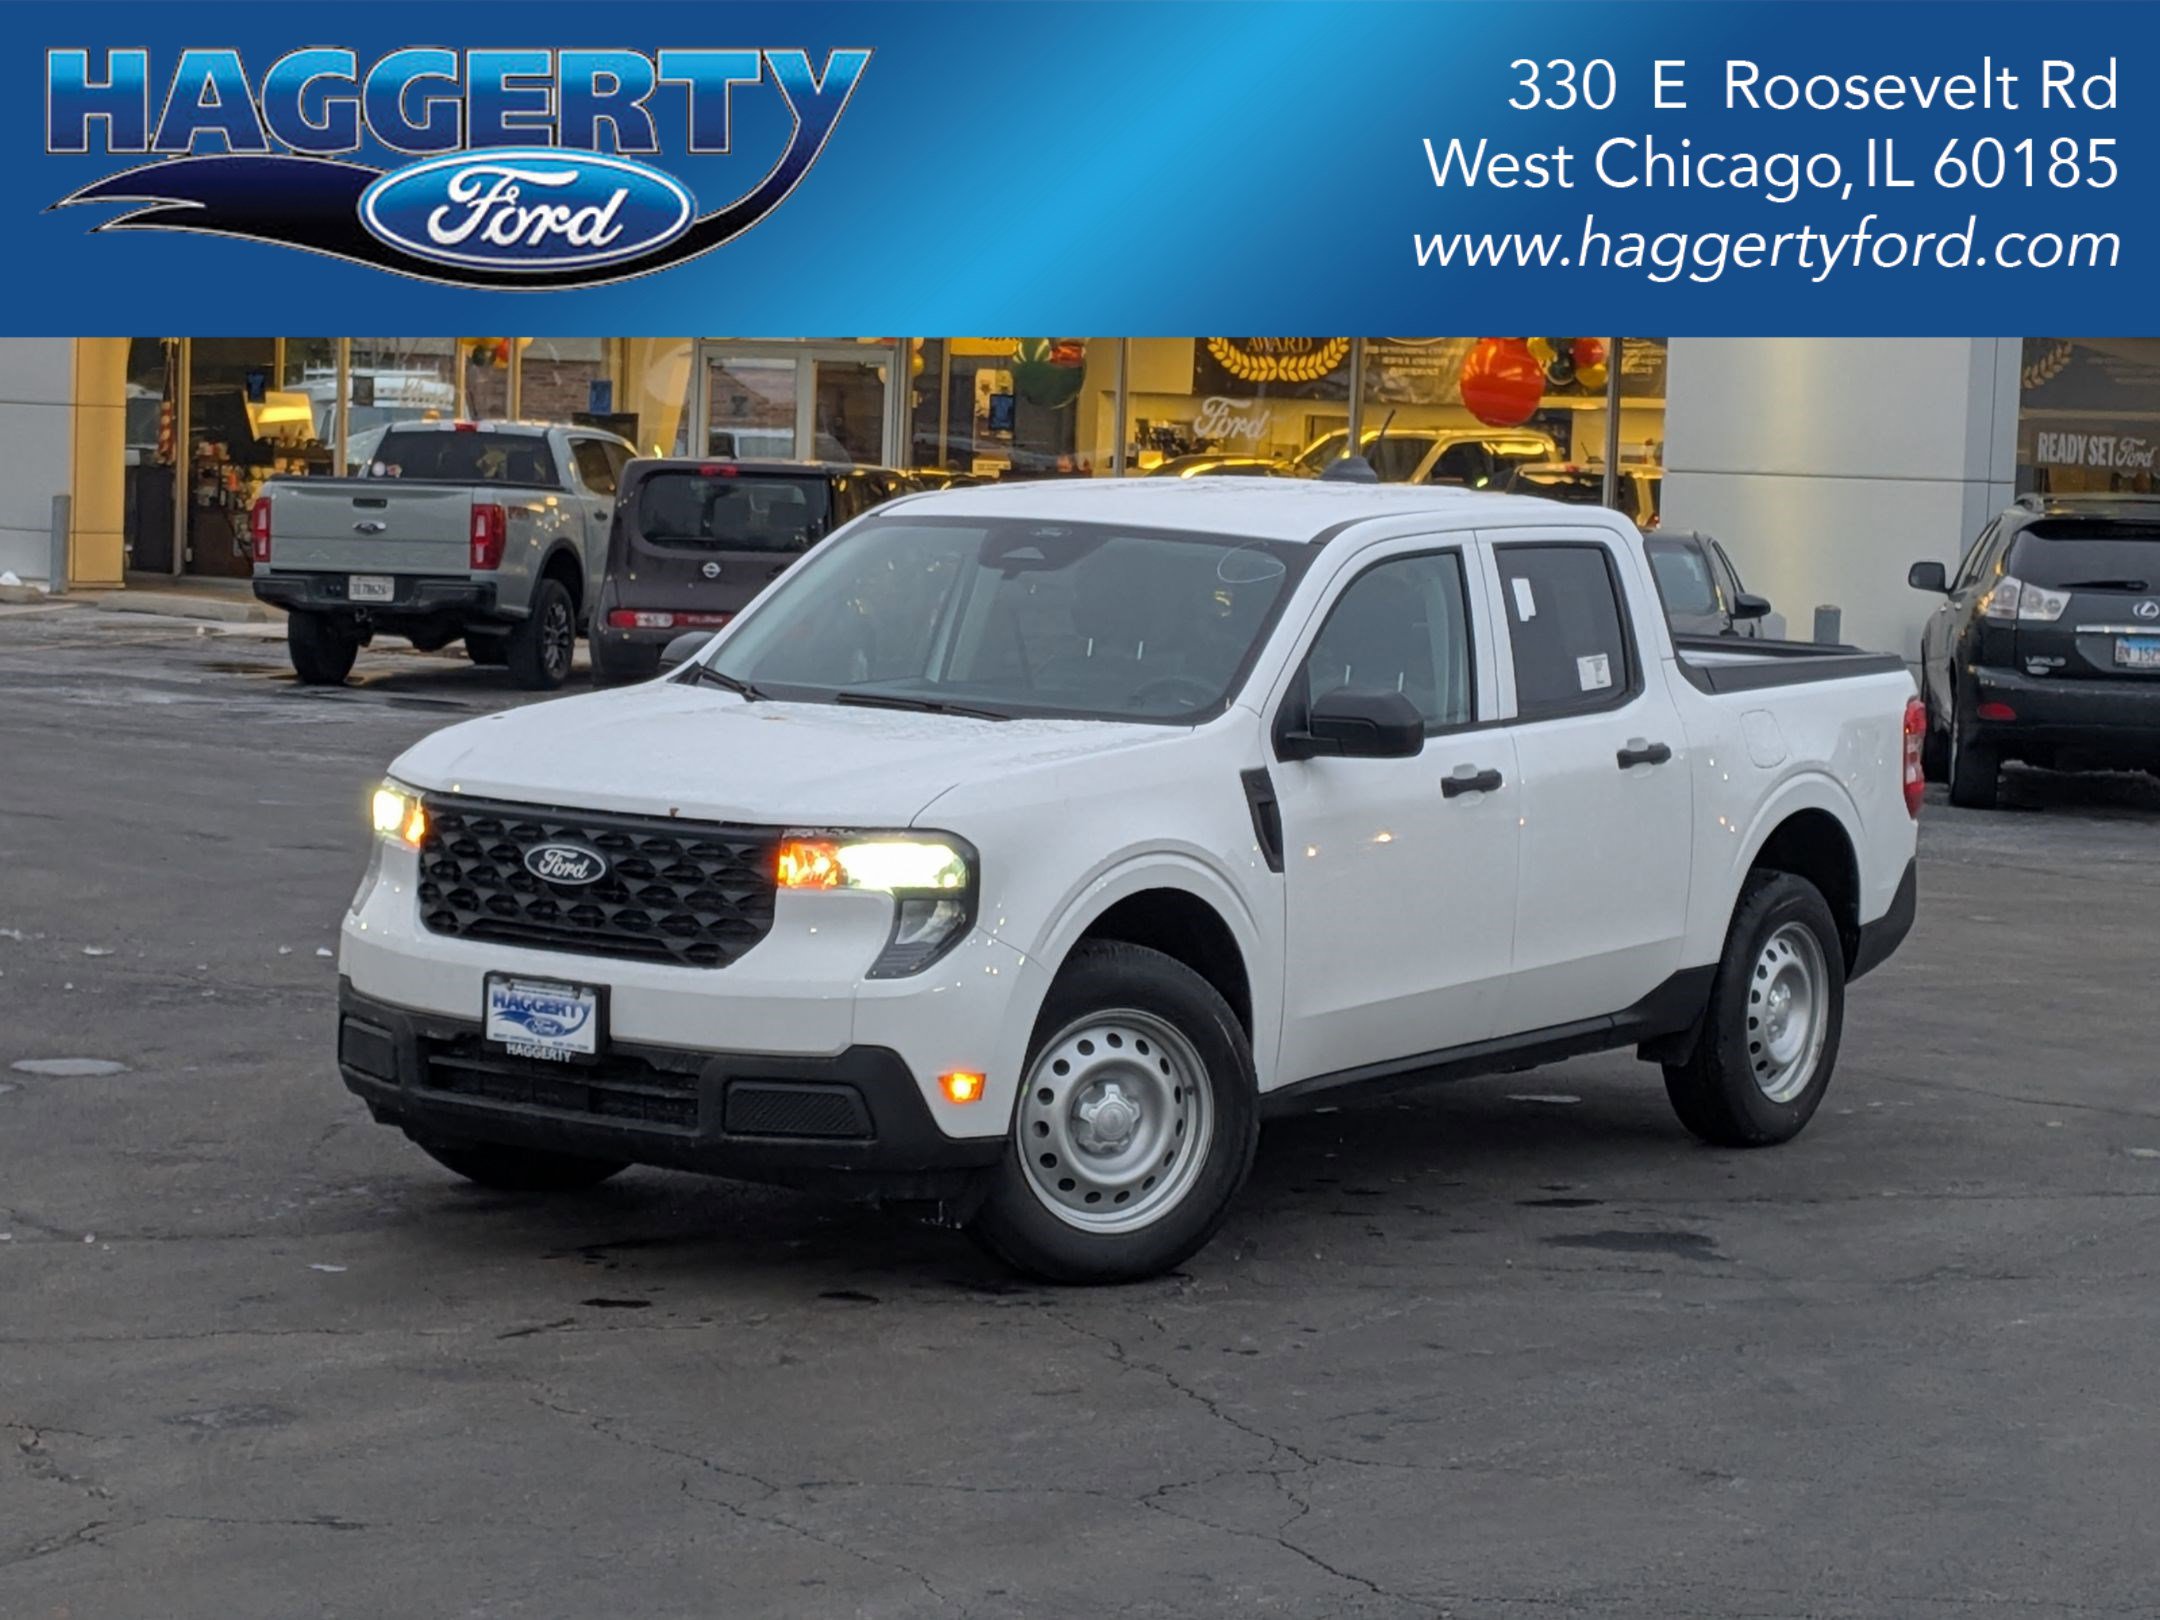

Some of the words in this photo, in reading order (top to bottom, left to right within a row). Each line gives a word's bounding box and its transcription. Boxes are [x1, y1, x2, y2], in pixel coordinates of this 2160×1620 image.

[1193, 396, 1270, 438] Ford
[2037, 431, 2087, 464] READY
[2088, 435, 2117, 466] SET
[2115, 437, 2159, 468] Ford
[538, 849, 590, 879] Ford
[492, 989, 593, 1019] HAGGERTY
[505, 1043, 572, 1063] HAGGERTY
